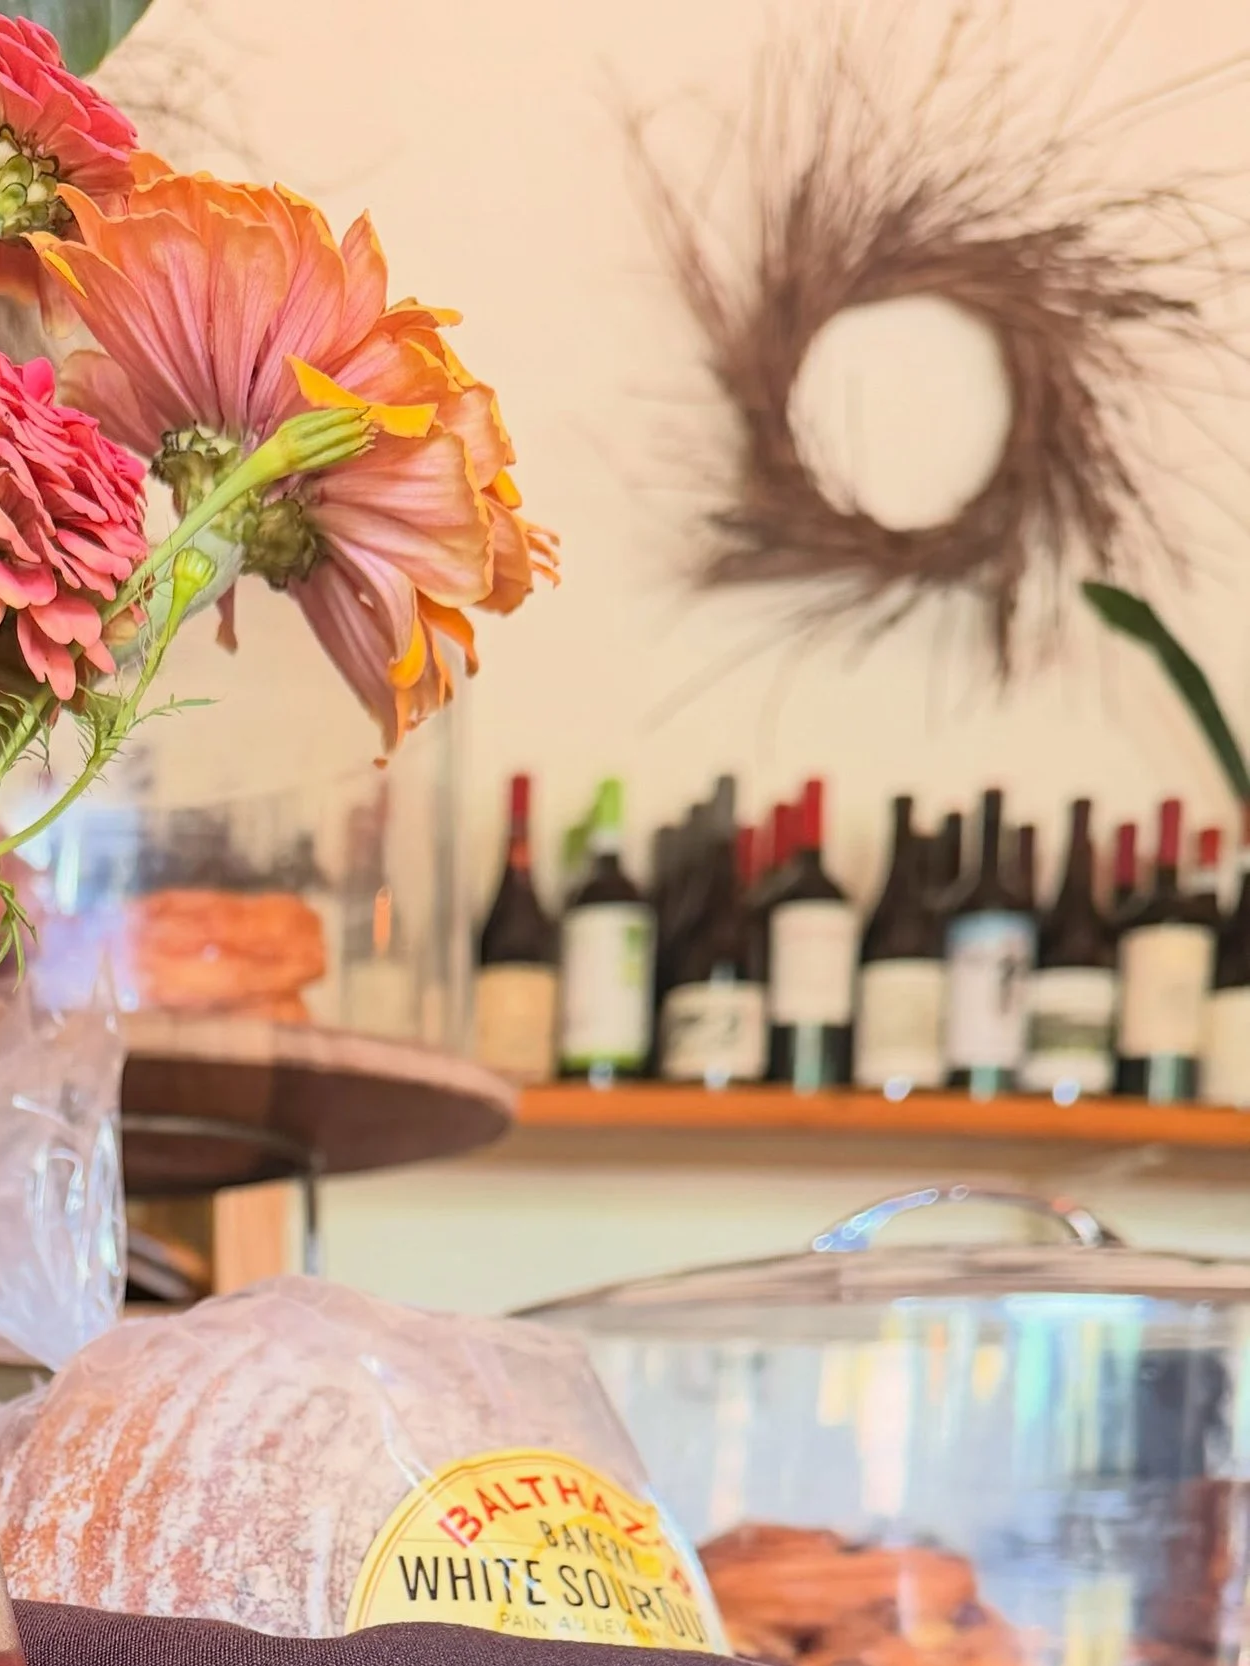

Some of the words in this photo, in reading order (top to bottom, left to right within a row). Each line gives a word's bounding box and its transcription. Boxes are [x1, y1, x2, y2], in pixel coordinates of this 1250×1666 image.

[437, 1474, 692, 1598] BALTHAZ
[537, 1519, 640, 1575] BAKERY
[399, 1555, 546, 1606] WHITE
[499, 1611, 547, 1632] PAIN
